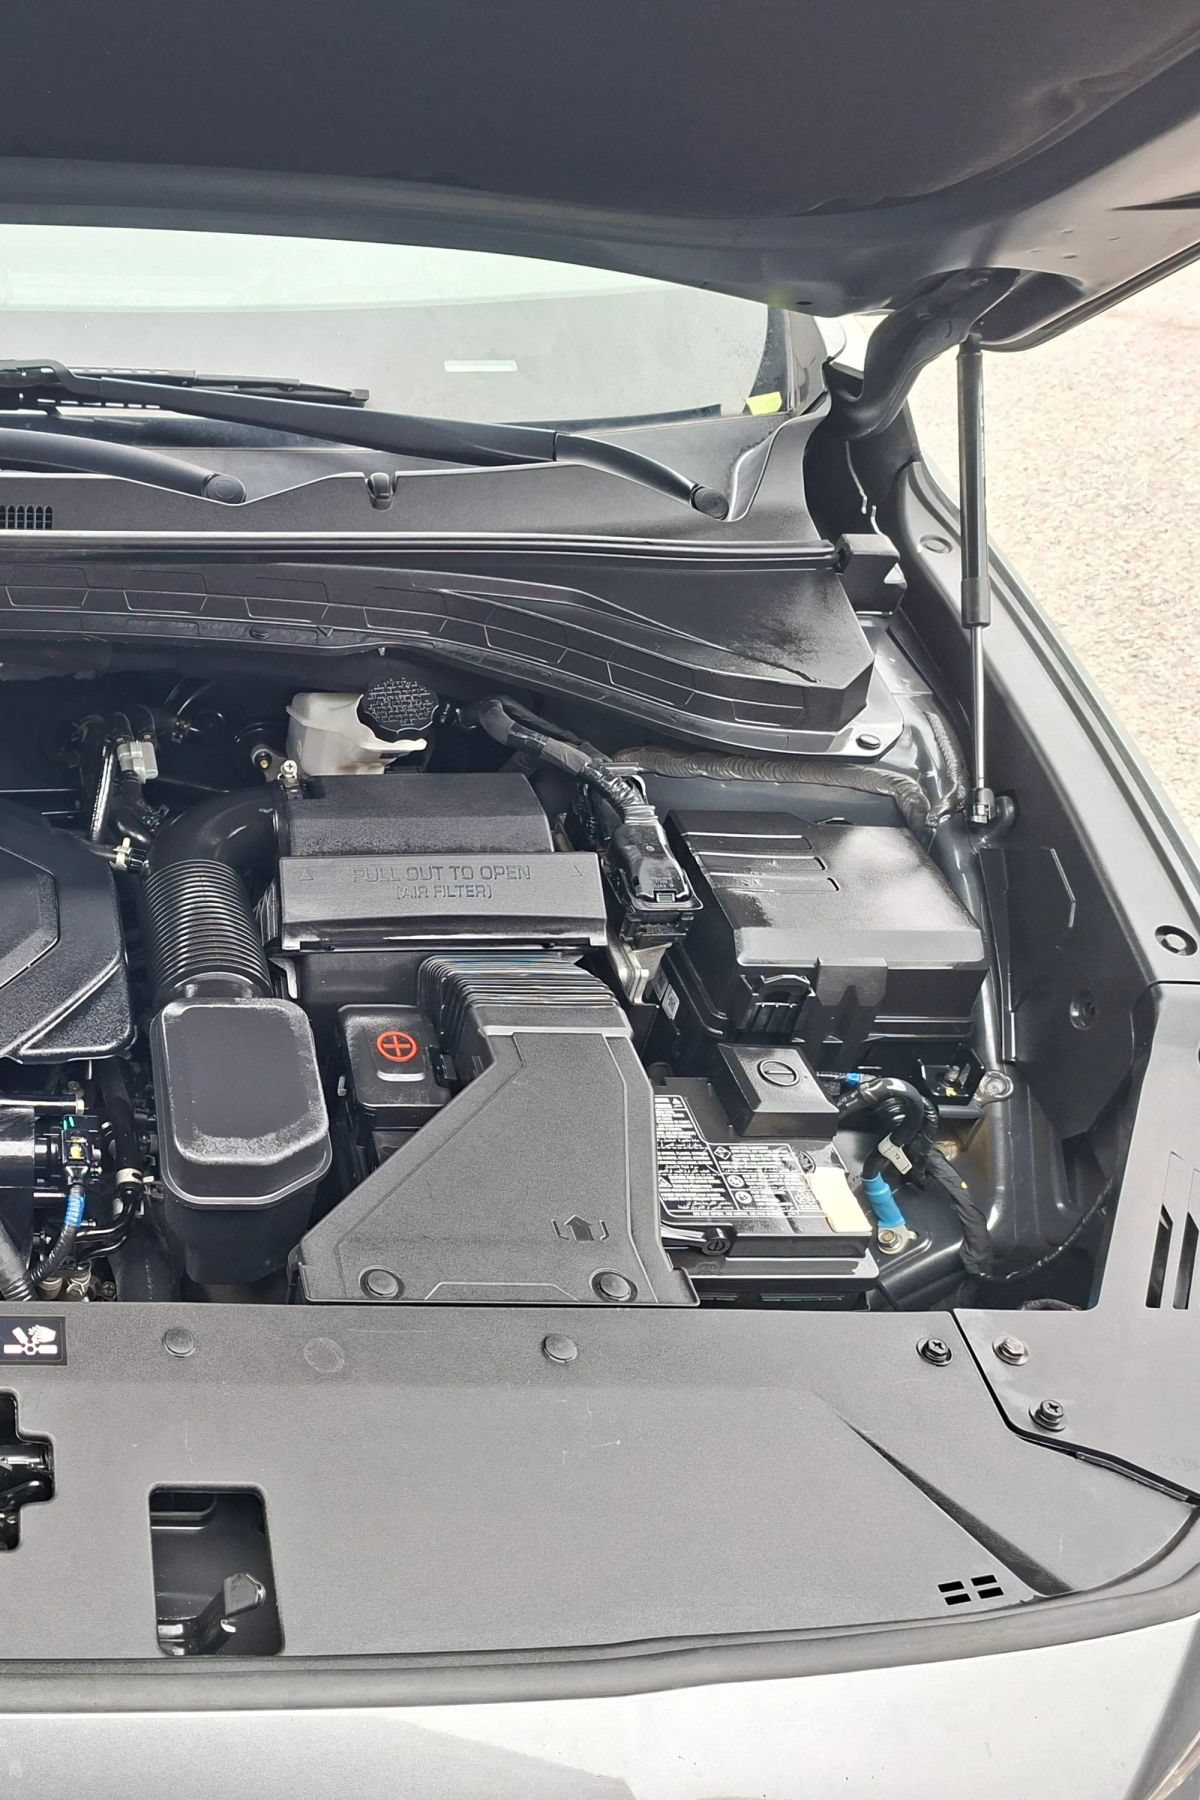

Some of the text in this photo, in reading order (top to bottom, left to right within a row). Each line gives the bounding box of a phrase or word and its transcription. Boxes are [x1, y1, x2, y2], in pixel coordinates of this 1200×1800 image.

[352, 864, 531, 883] PULL OUT TO OPEN
[434, 884, 492, 899] FILTER)
